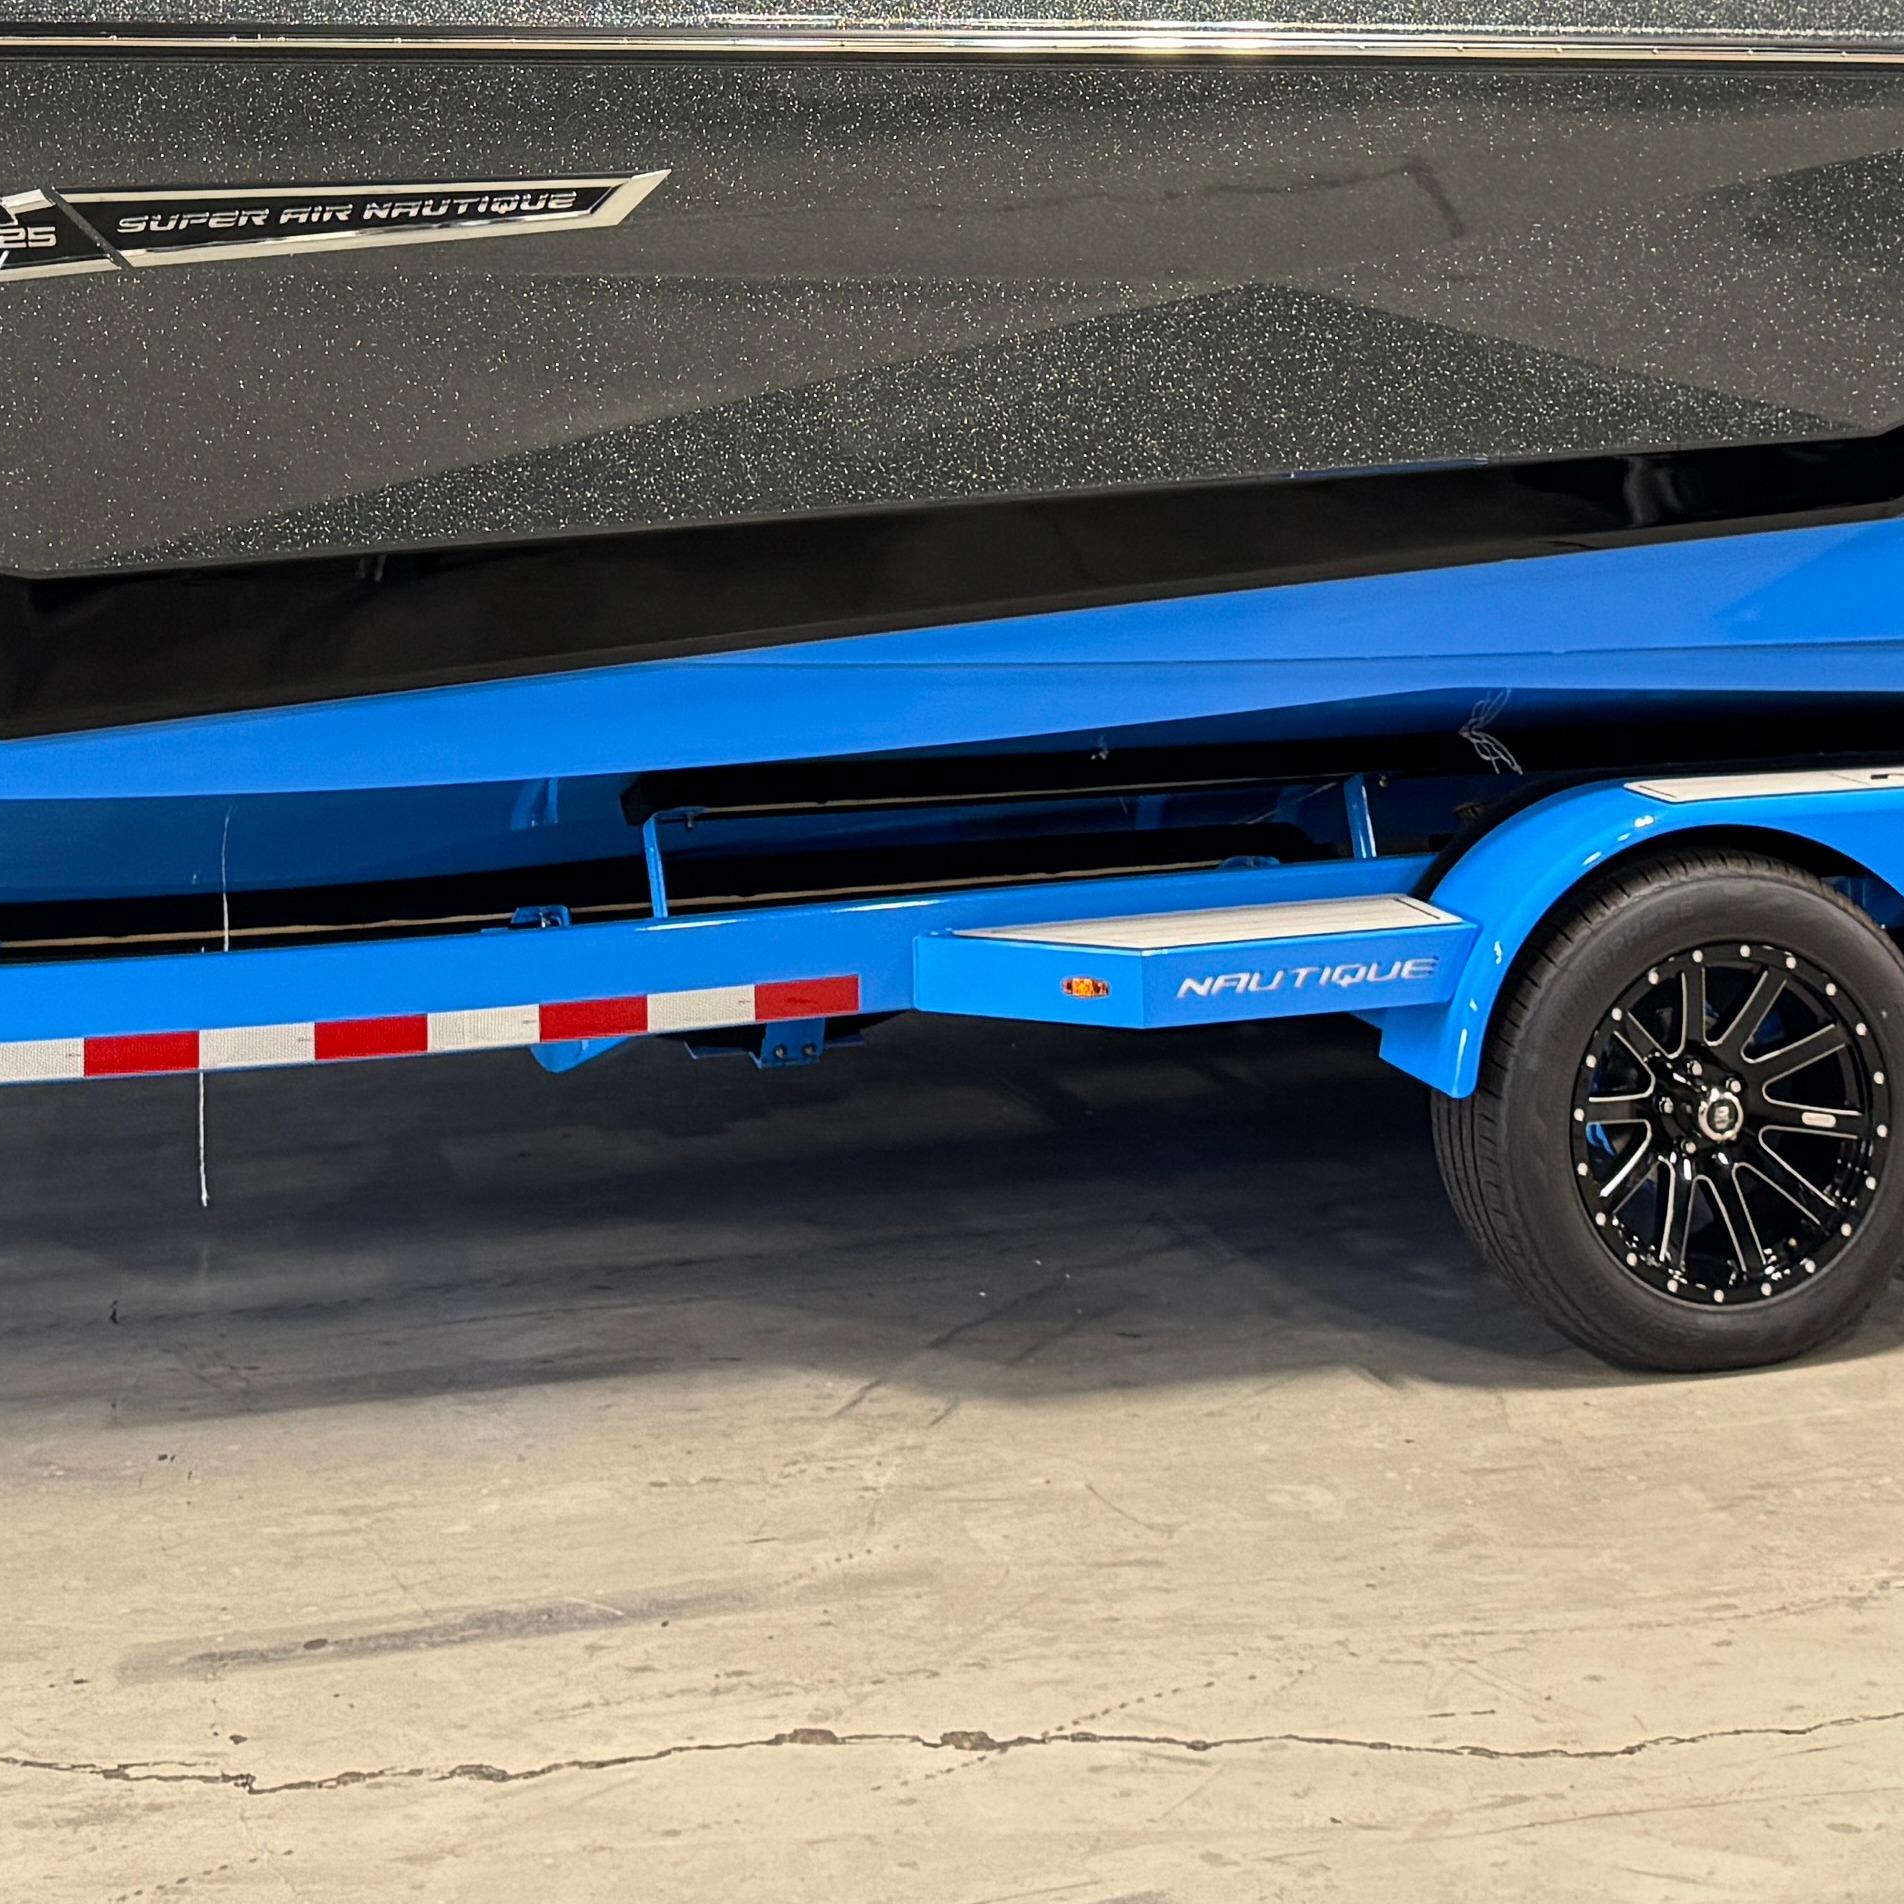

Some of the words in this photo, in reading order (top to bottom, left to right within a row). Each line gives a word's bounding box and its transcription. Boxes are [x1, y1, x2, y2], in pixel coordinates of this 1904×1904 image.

[116, 208, 270, 234] SUPER
[279, 203, 353, 225] AIR
[362, 191, 577, 220] NAUTIQUE
[1177, 957, 1437, 999] NAUTIQUE
